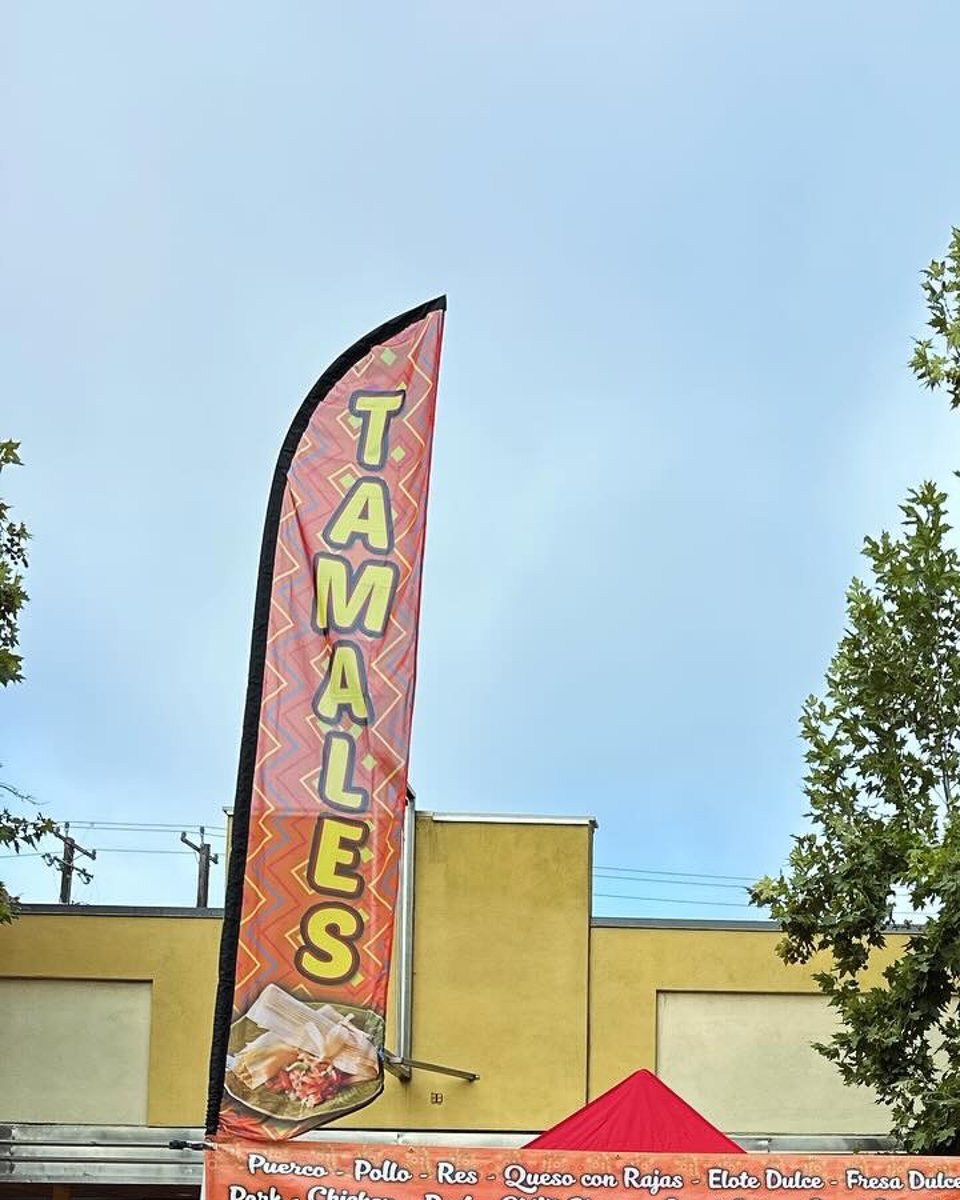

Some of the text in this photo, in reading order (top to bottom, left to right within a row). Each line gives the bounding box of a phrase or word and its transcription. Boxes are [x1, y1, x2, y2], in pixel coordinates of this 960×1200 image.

[295, 389, 406, 985] TAMALES
[247, 1154, 328, 1178] Puerco
[354, 1158, 412, 1183] Pollo
[437, 1163, 477, 1185] Res
[504, 1165, 575, 1194] Queso
[580, 1174, 617, 1188] con
[623, 1167, 683, 1195] Rajas
[708, 1168, 760, 1190] Elote
[764, 1169, 824, 1191] Dulce
[846, 1170, 903, 1191] Fresa
